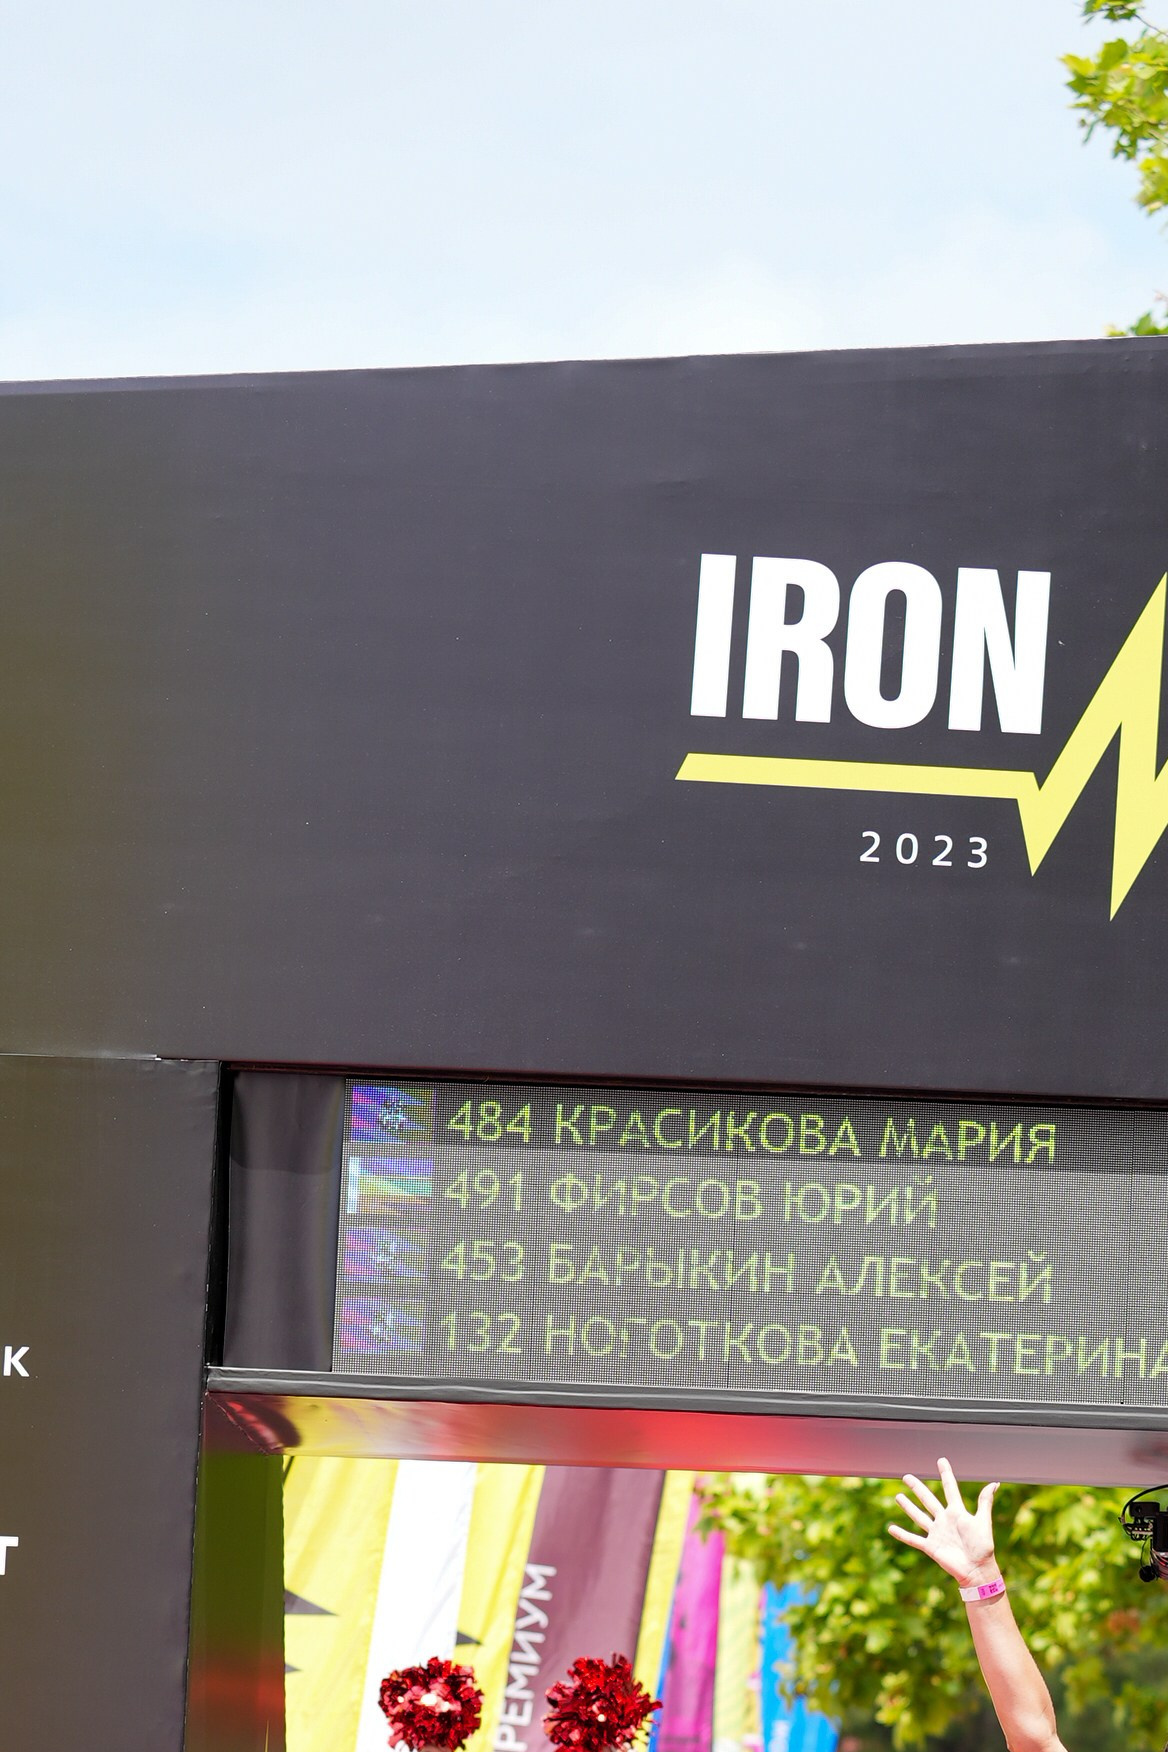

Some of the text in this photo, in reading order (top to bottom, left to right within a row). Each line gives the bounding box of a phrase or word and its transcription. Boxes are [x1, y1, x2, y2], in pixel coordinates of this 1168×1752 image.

[690, 553, 1051, 735] IRON
[858, 831, 990, 870] 2023
[447, 1101, 532, 1144] 484
[555, 1104, 861, 1157] КРАСИКОВА
[880, 1118, 1057, 1164] МАРИЯ
[444, 1169, 526, 1212] 491
[550, 1171, 764, 1221] ФИРСОВ
[784, 1174, 939, 1230] ЮРИЙ
[441, 1239, 526, 1284] 453
[548, 1241, 795, 1294] БАРЫКИН
[816, 1249, 1054, 1304] АЛЕКСЕЙ
[439, 1310, 523, 1355] 132
[543, 1313, 858, 1369] НОГОТКОВА
